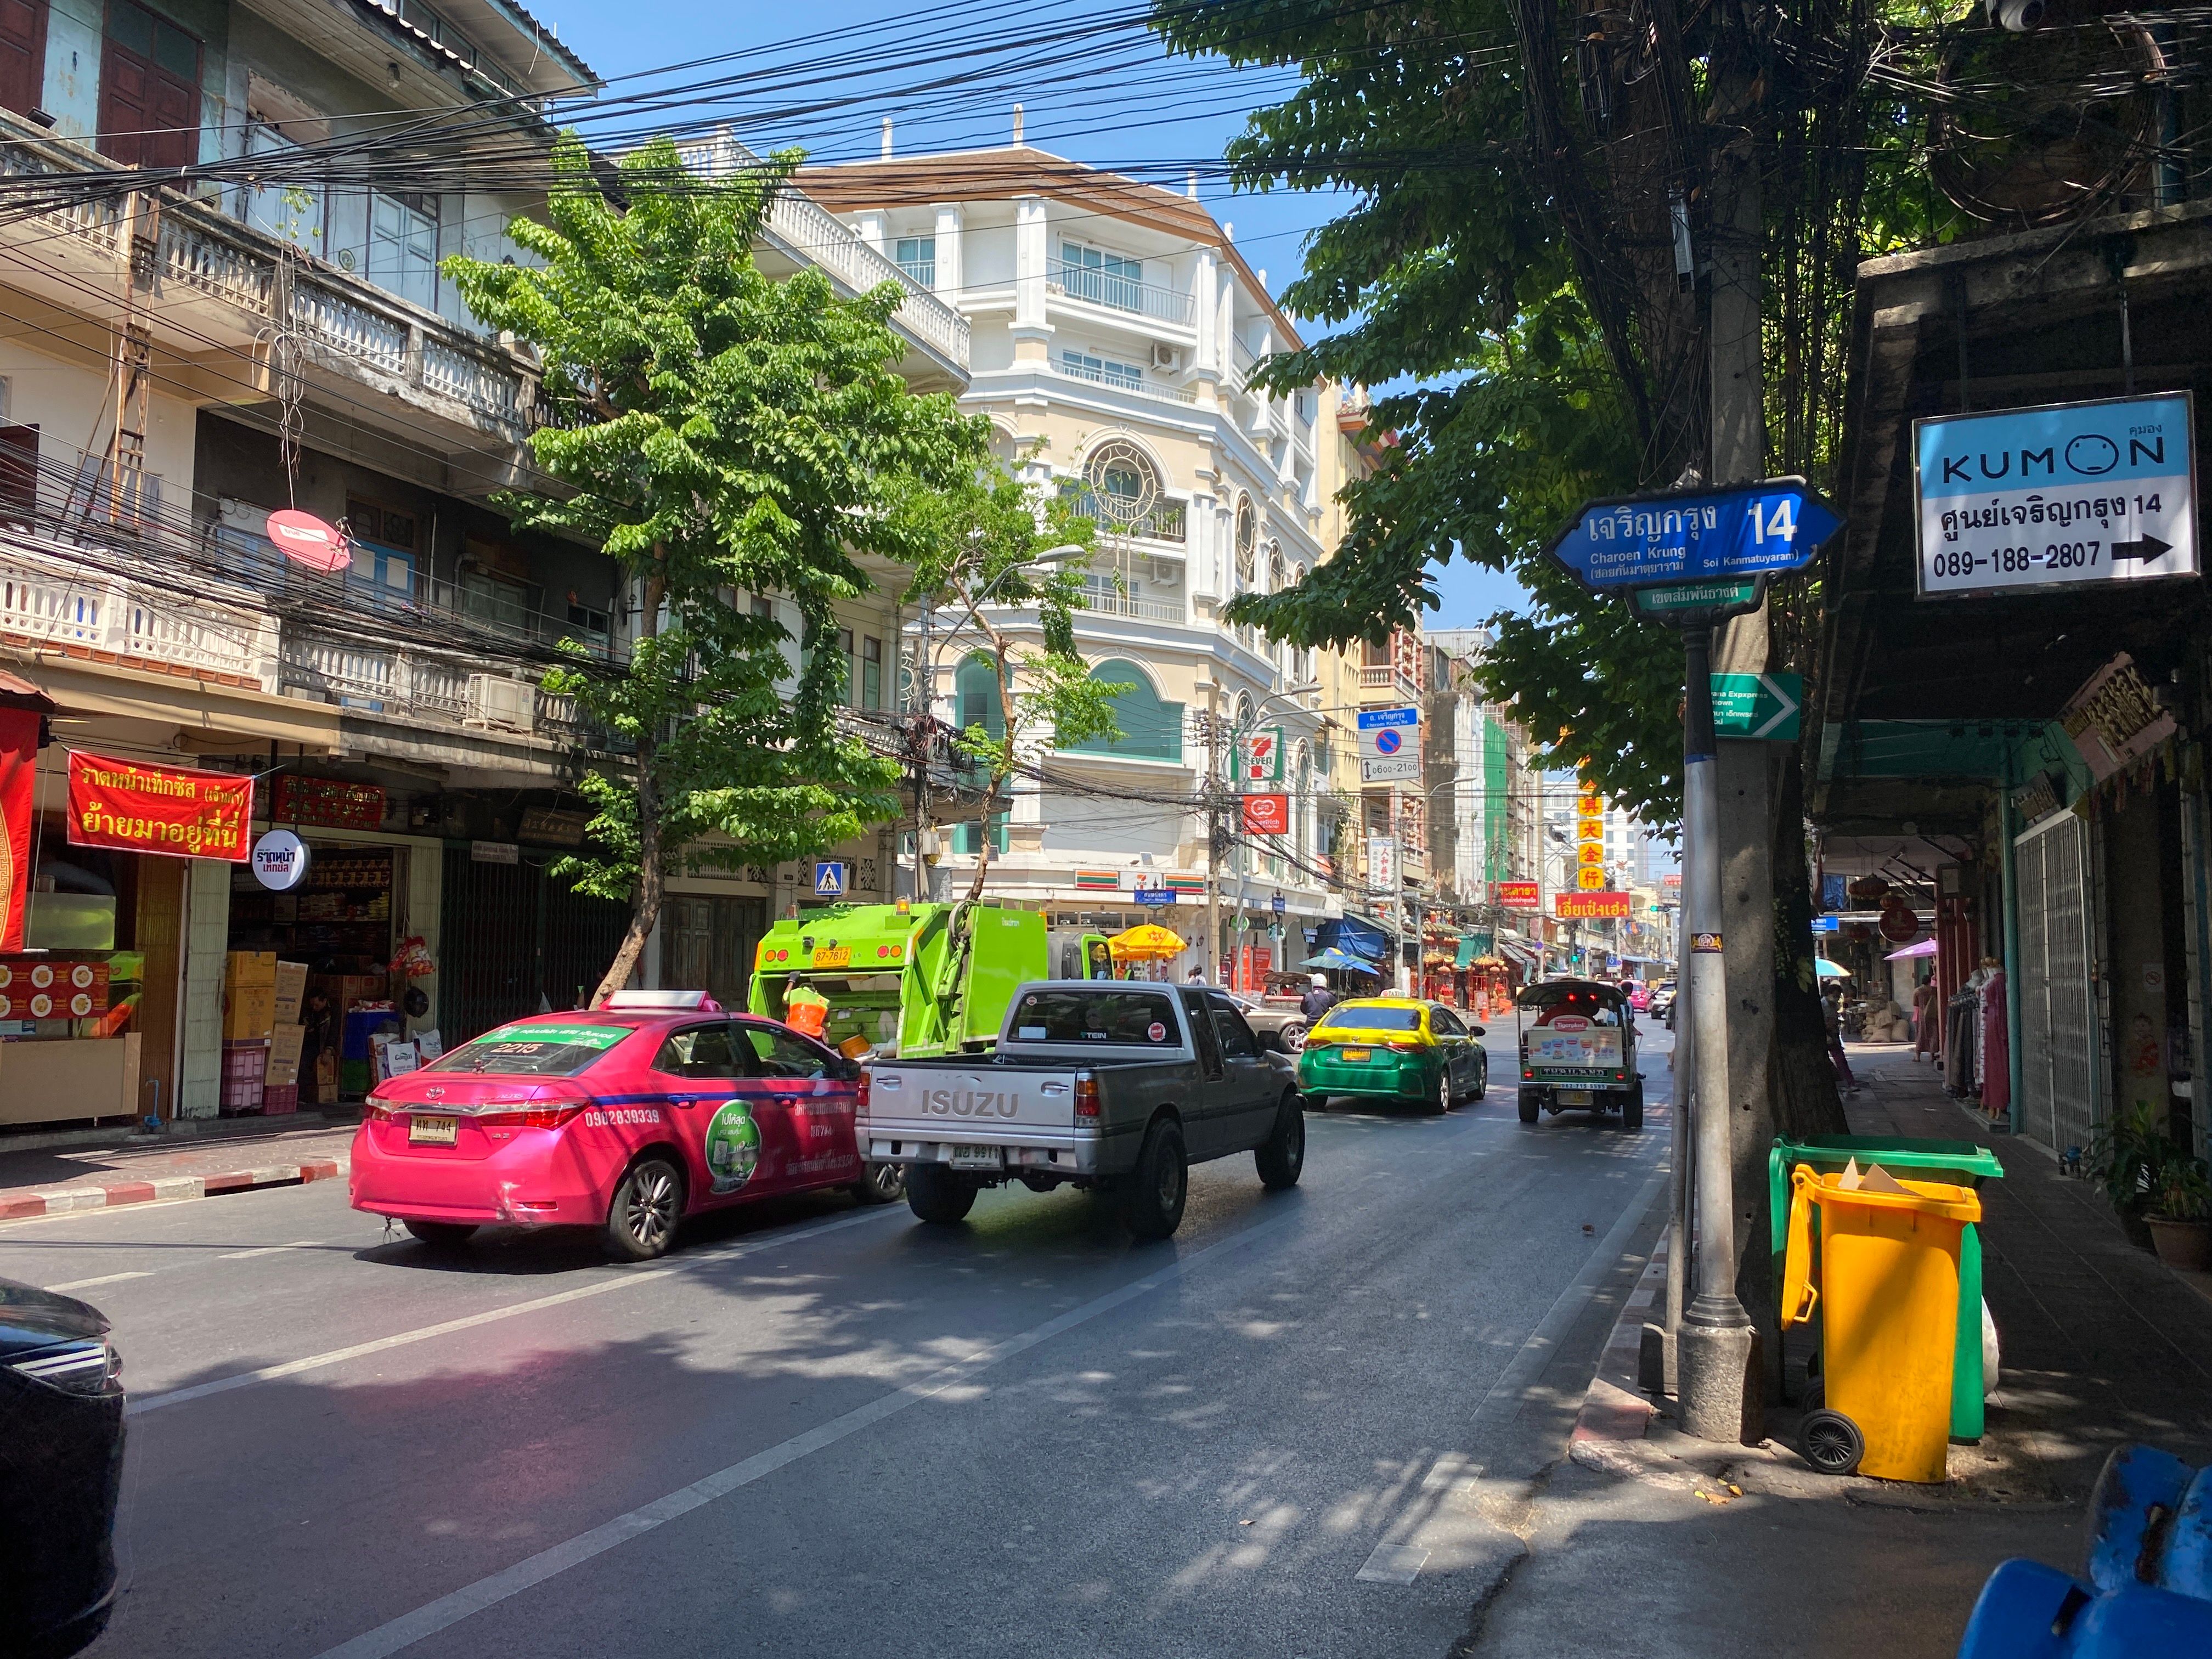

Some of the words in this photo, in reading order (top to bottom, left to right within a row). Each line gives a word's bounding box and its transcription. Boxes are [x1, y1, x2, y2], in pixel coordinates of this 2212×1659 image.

[2129, 424, 2163, 436] คุมอง
[1943, 434, 2165, 484] KUMON
[1589, 505, 1716, 543] เจริญกรุง
[1747, 499, 1797, 544] 14
[1940, 494, 2126, 542] ศูนย์เจริญกรุง
[2134, 493, 2162, 515] 14
[284, 528, 301, 536] true
[1590, 550, 1641, 565] Charoen
[1647, 545, 1686, 560] Krung
[1703, 558, 1719, 568] Soi
[1723, 549, 1800, 567] Kanmatuyaram)
[1933, 540, 2101, 578] 089-188-2807
[1651, 583, 1740, 606] เขตสัมพันธวงศ์
[1378, 712, 1406, 721] เจริญกรุง
[1372, 763, 1417, 775] 0600-2100
[83, 800, 240, 854] ย้ายมาอยู่ที่นี่
[257, 847, 295, 863] ราดหน้า
[816, 951, 849, 962] 67-7612
[490, 1043, 544, 1053] 2215
[1543, 1068, 1605, 1077] THAILAND
[922, 1090, 1018, 1118] ISUZU
[436, 1120, 451, 1132] 744
[585, 1109, 660, 1127] 0902839339
[721, 1113, 746, 1127] ไปให้สุด
